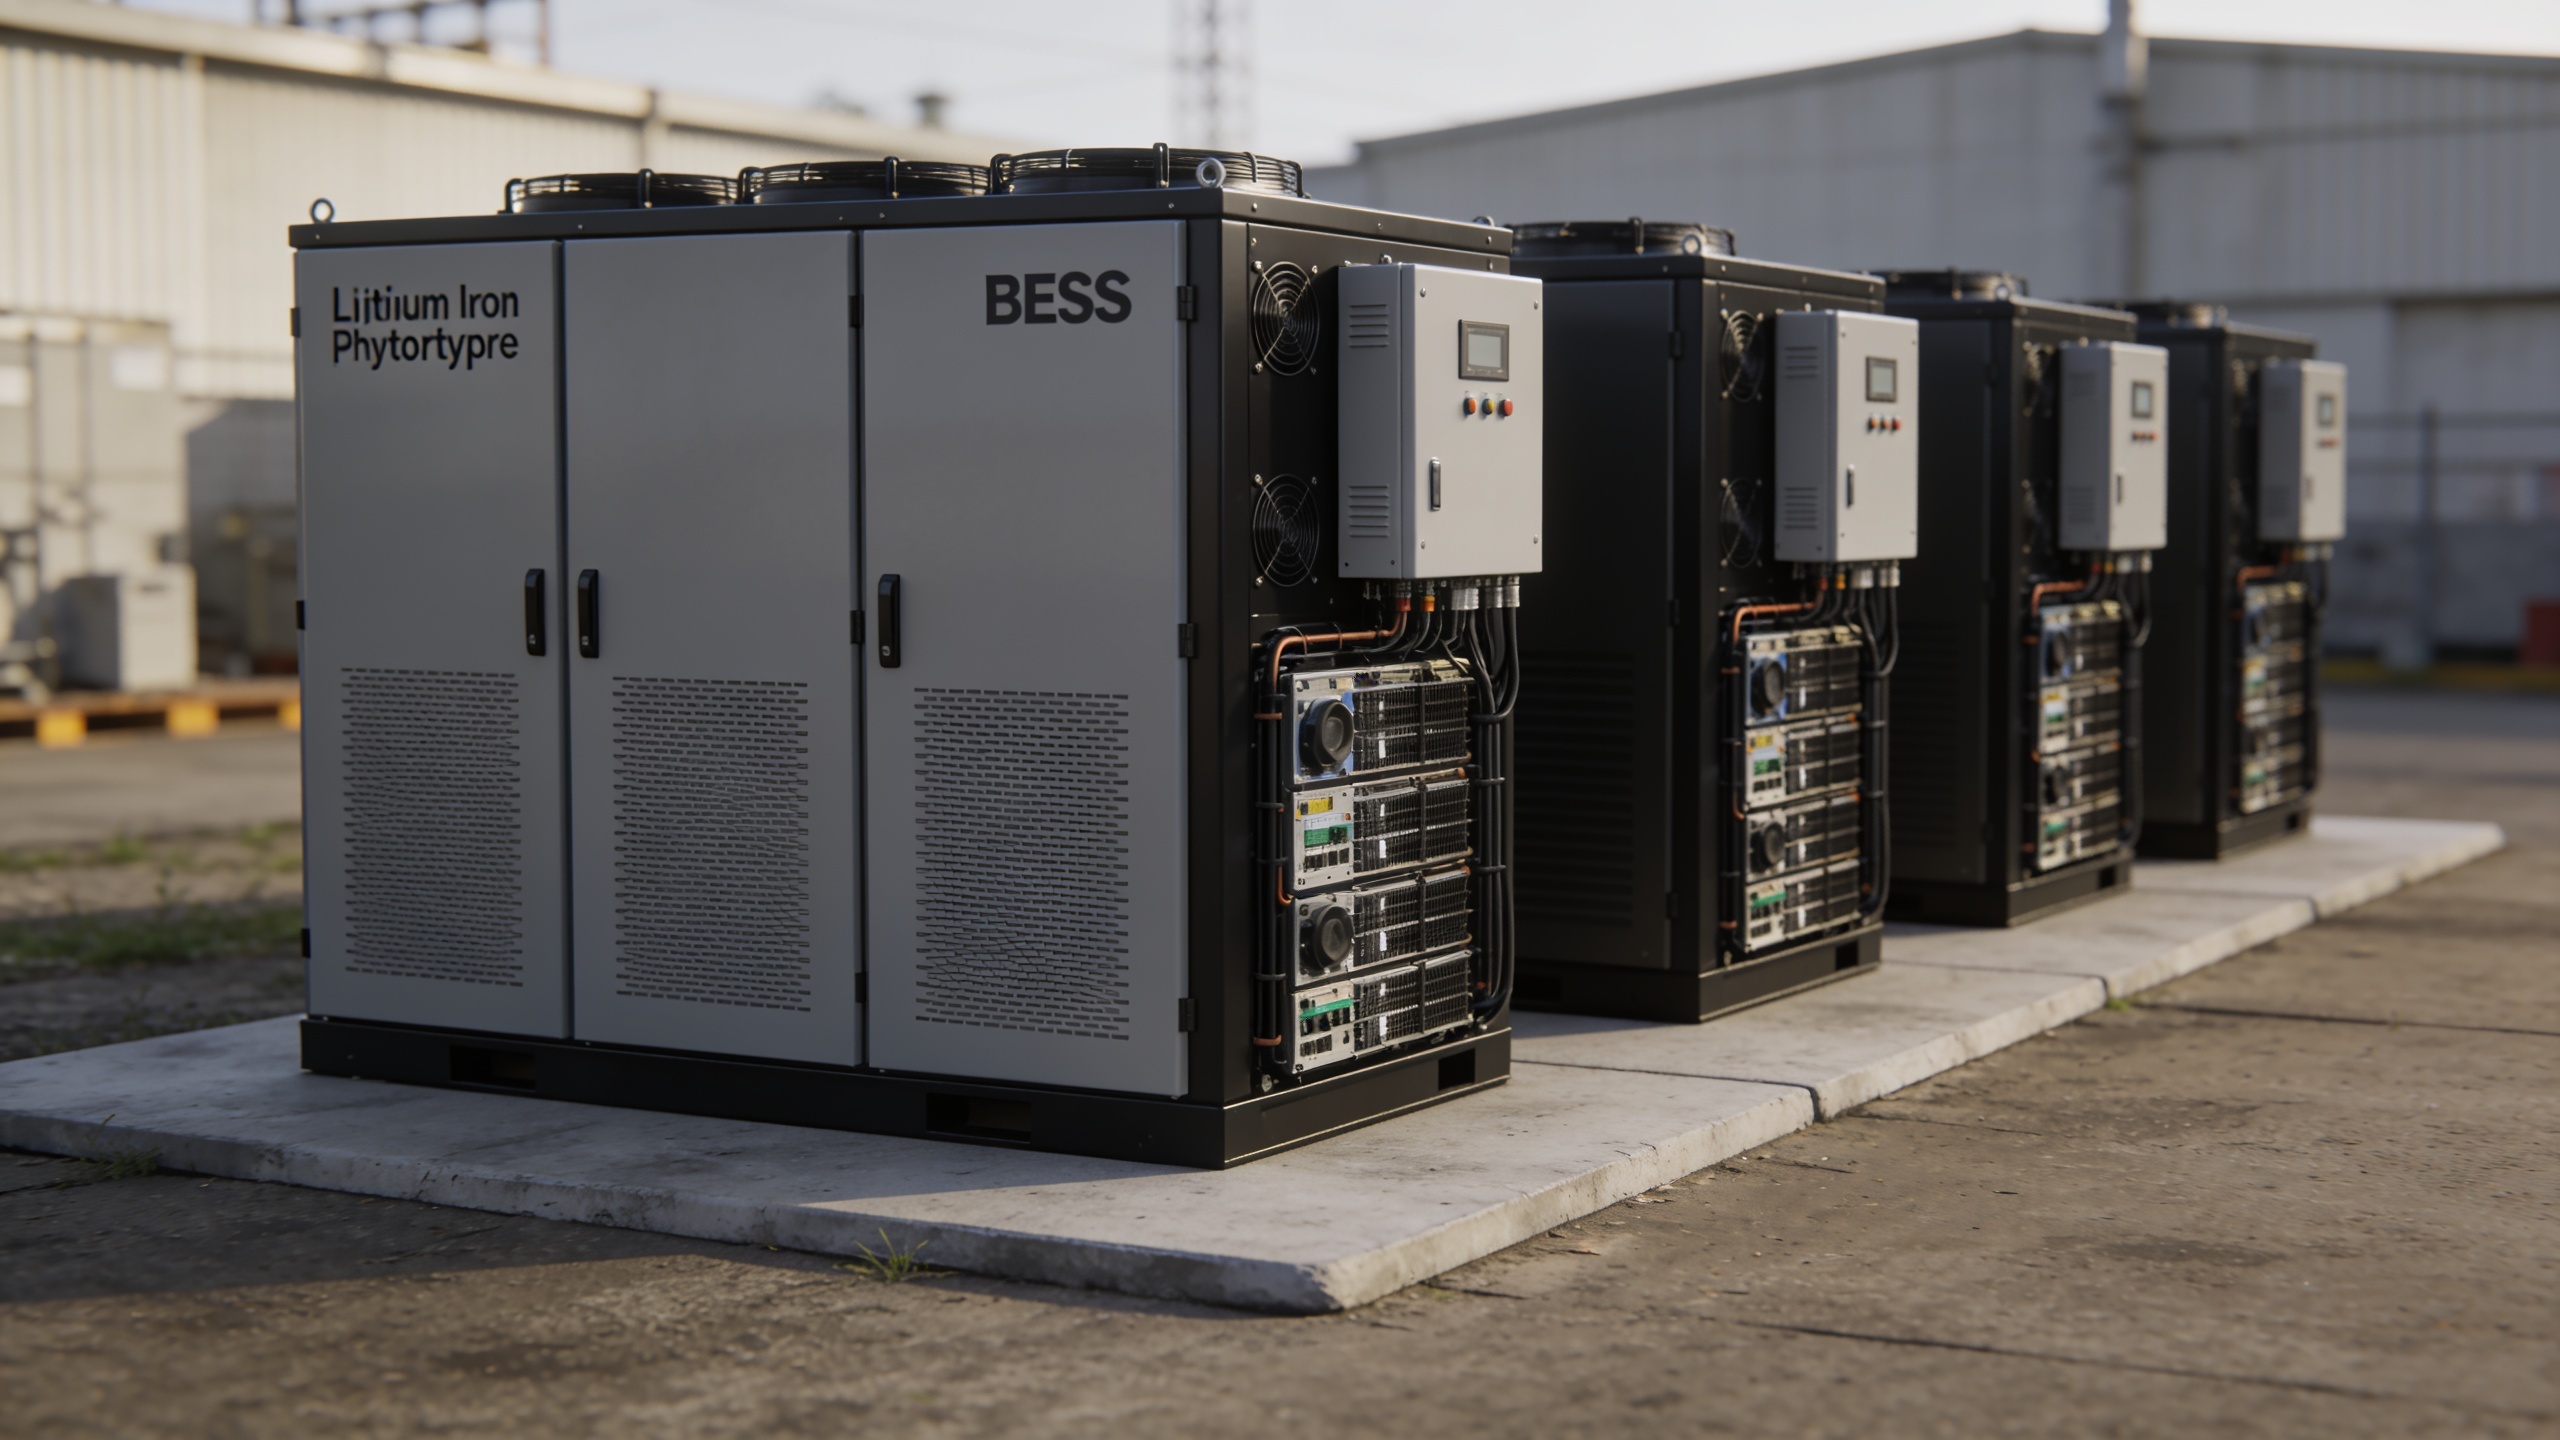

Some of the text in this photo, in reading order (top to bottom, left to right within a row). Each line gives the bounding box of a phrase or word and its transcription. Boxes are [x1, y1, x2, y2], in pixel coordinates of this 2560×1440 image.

[460, 284, 519, 319] Iron
[986, 270, 1132, 325] BESS
[333, 328, 519, 371] Phytortypre
